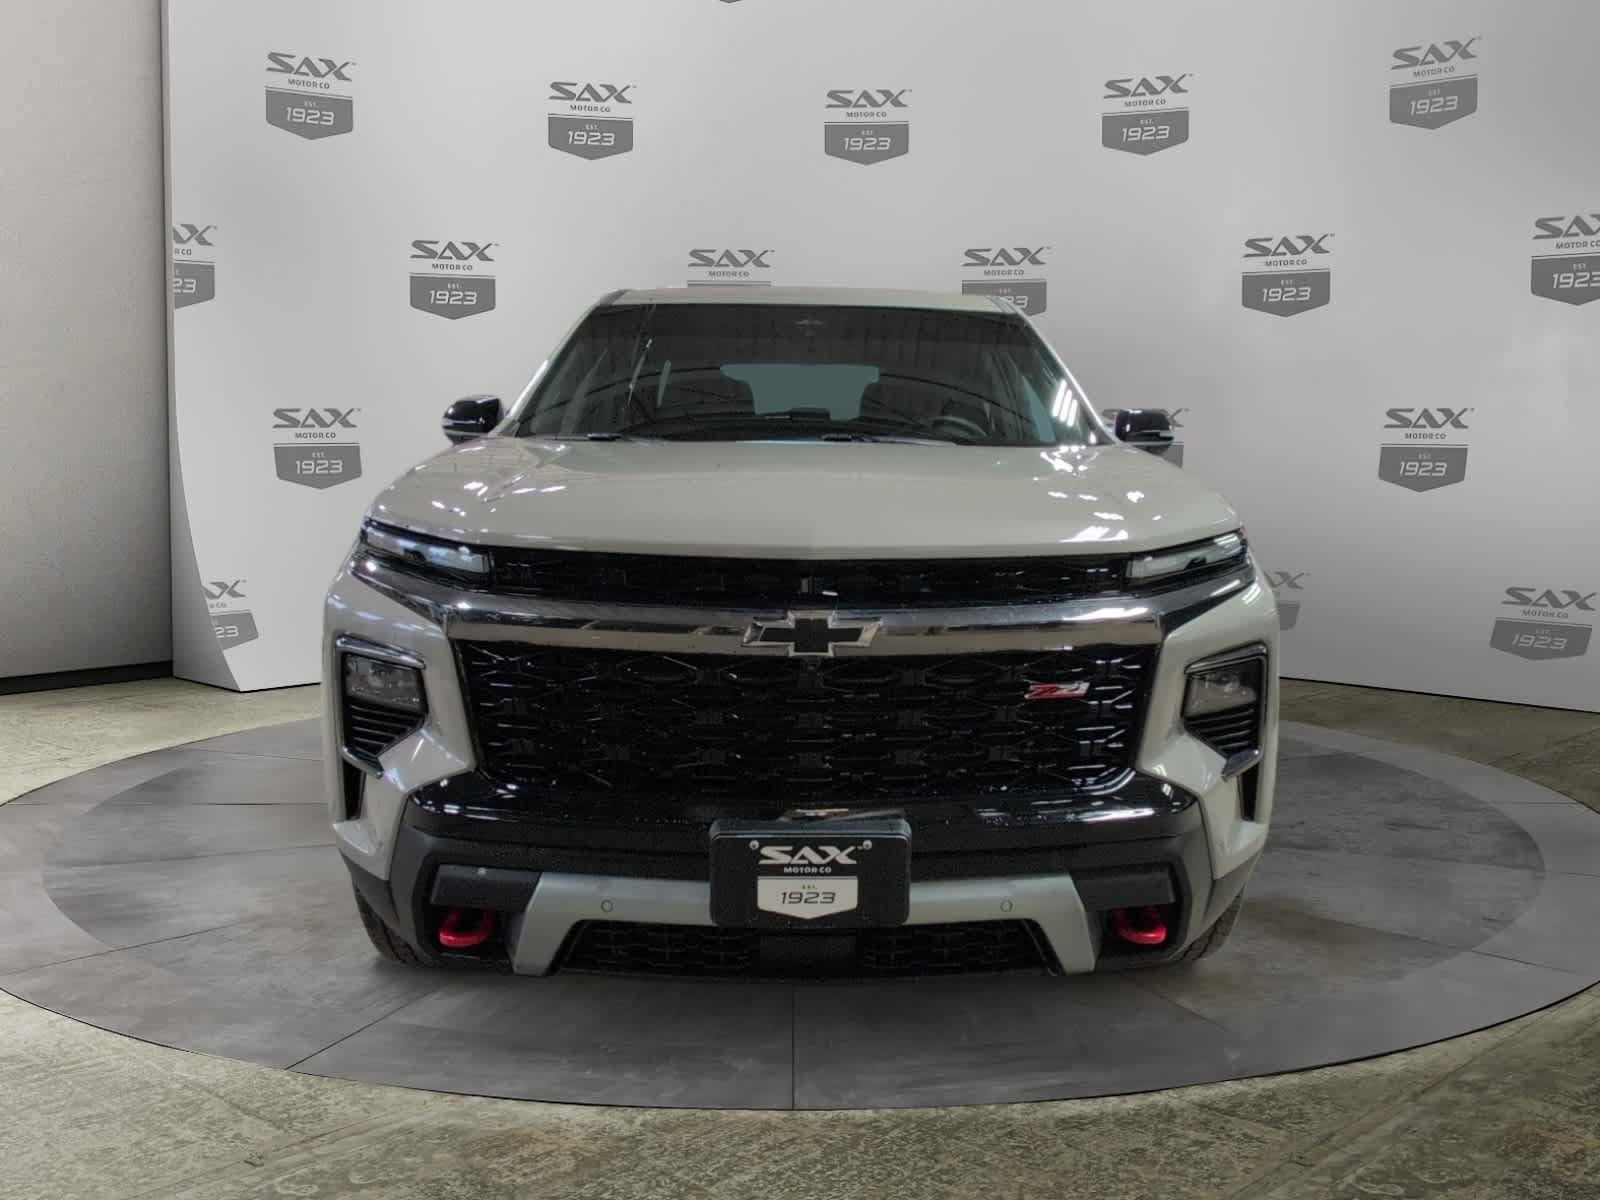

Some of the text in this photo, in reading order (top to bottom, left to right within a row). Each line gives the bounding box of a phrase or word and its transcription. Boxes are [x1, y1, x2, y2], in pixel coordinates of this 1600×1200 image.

[1391, 38, 1477, 70] SAX
[266, 51, 353, 81] SAX
[549, 81, 632, 104] SAX
[1104, 73, 1188, 99] SAX
[825, 90, 908, 108] SAX
[1410, 96, 1458, 116] 1923
[286, 106, 336, 126] 1923
[568, 130, 615, 146] 1923
[1122, 126, 1170, 142] 1923
[844, 137, 891, 151] 1923
[410, 240, 494, 261] SAX
[1243, 233, 1330, 258] SAX
[1555, 240, 1588, 249] MOTOR
[688, 249, 770, 268] SAX
[962, 247, 1047, 266] SAX
[174, 279, 196, 293] 23
[1263, 287, 1311, 302] 1923
[430, 290, 477, 305] 1923
[272, 408, 358, 429] SAX
[1384, 408, 1469, 429] SAX
[296, 460, 343, 474] 1923
[1400, 461, 1448, 476] 1923
[1501, 587, 1597, 611] SAX
[215, 626, 239, 638] 23
[1512, 633, 1567, 649] 1923
[758, 846, 857, 865] SAX
[783, 866, 832, 874] MOTOR CO
[781, 891, 836, 904] 1923
